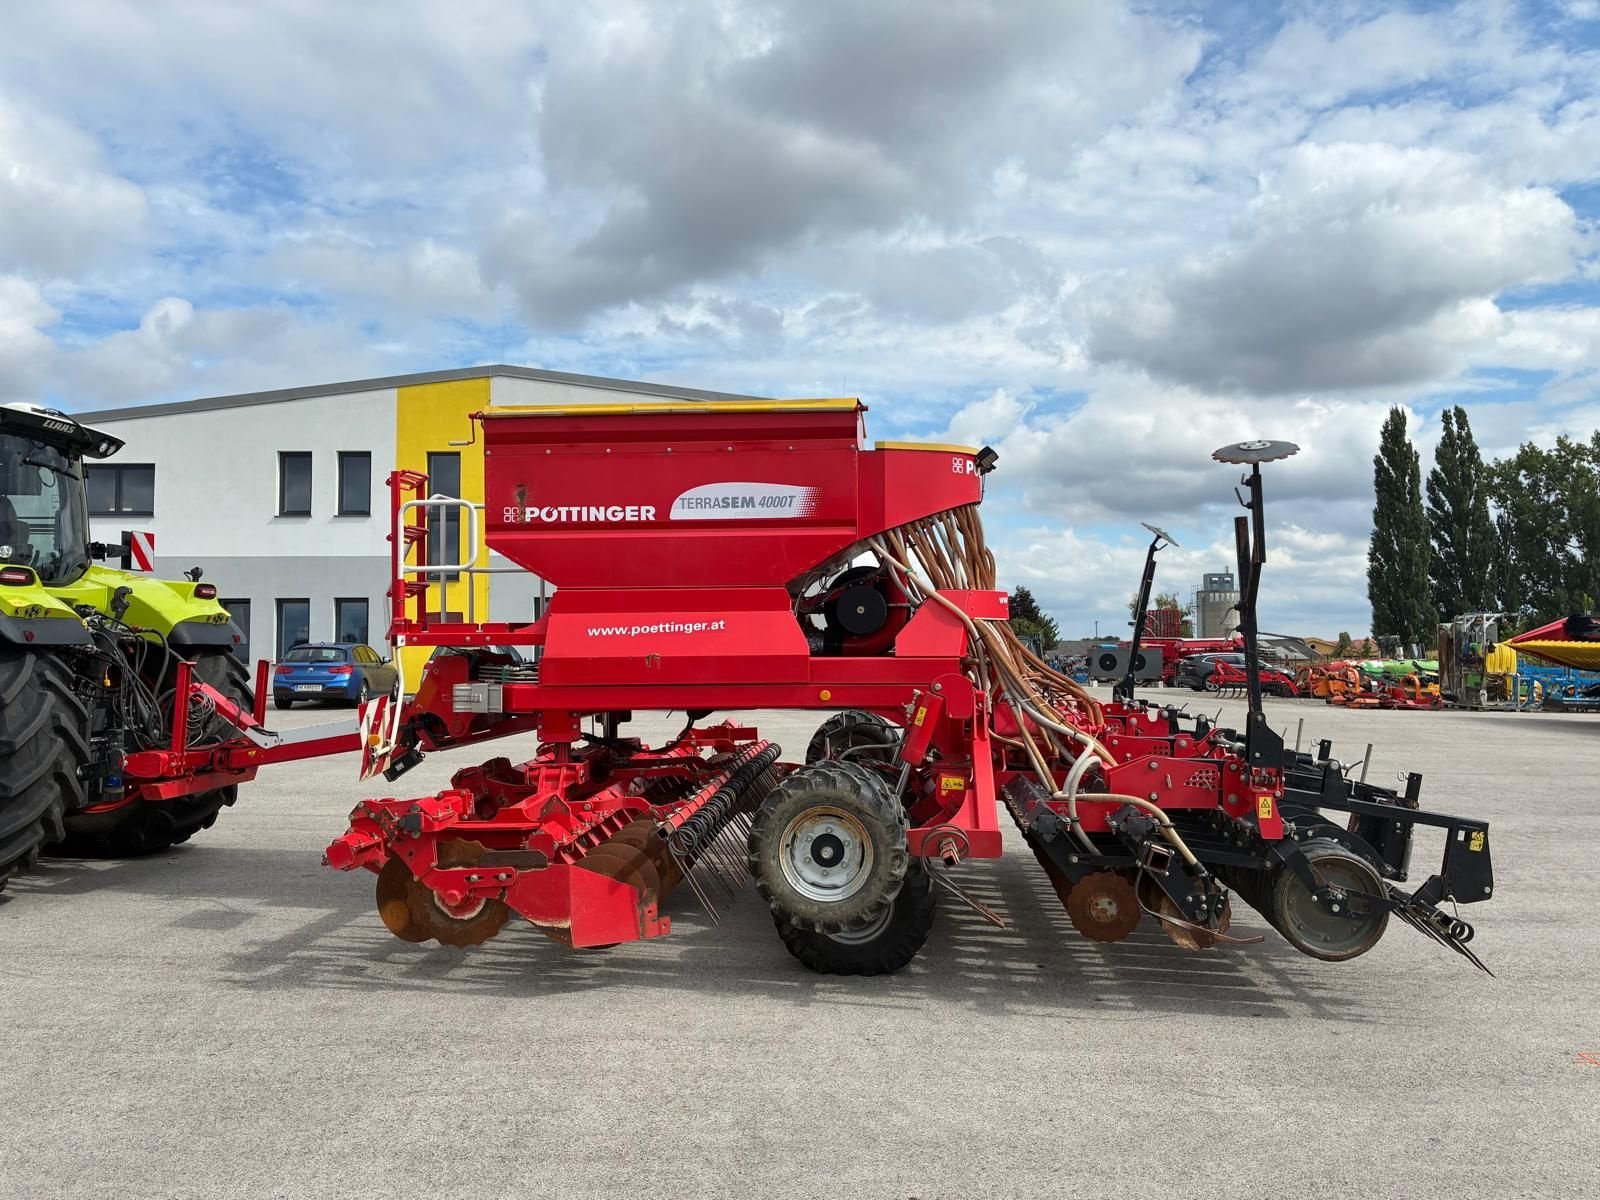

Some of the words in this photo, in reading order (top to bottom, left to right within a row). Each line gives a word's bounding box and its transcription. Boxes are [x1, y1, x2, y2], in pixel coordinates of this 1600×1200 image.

[42, 419, 77, 434] CLAAS
[679, 496, 756, 510] TERRASEM
[758, 495, 797, 509] 4000T
[587, 619, 726, 637] www.poettinger.at
